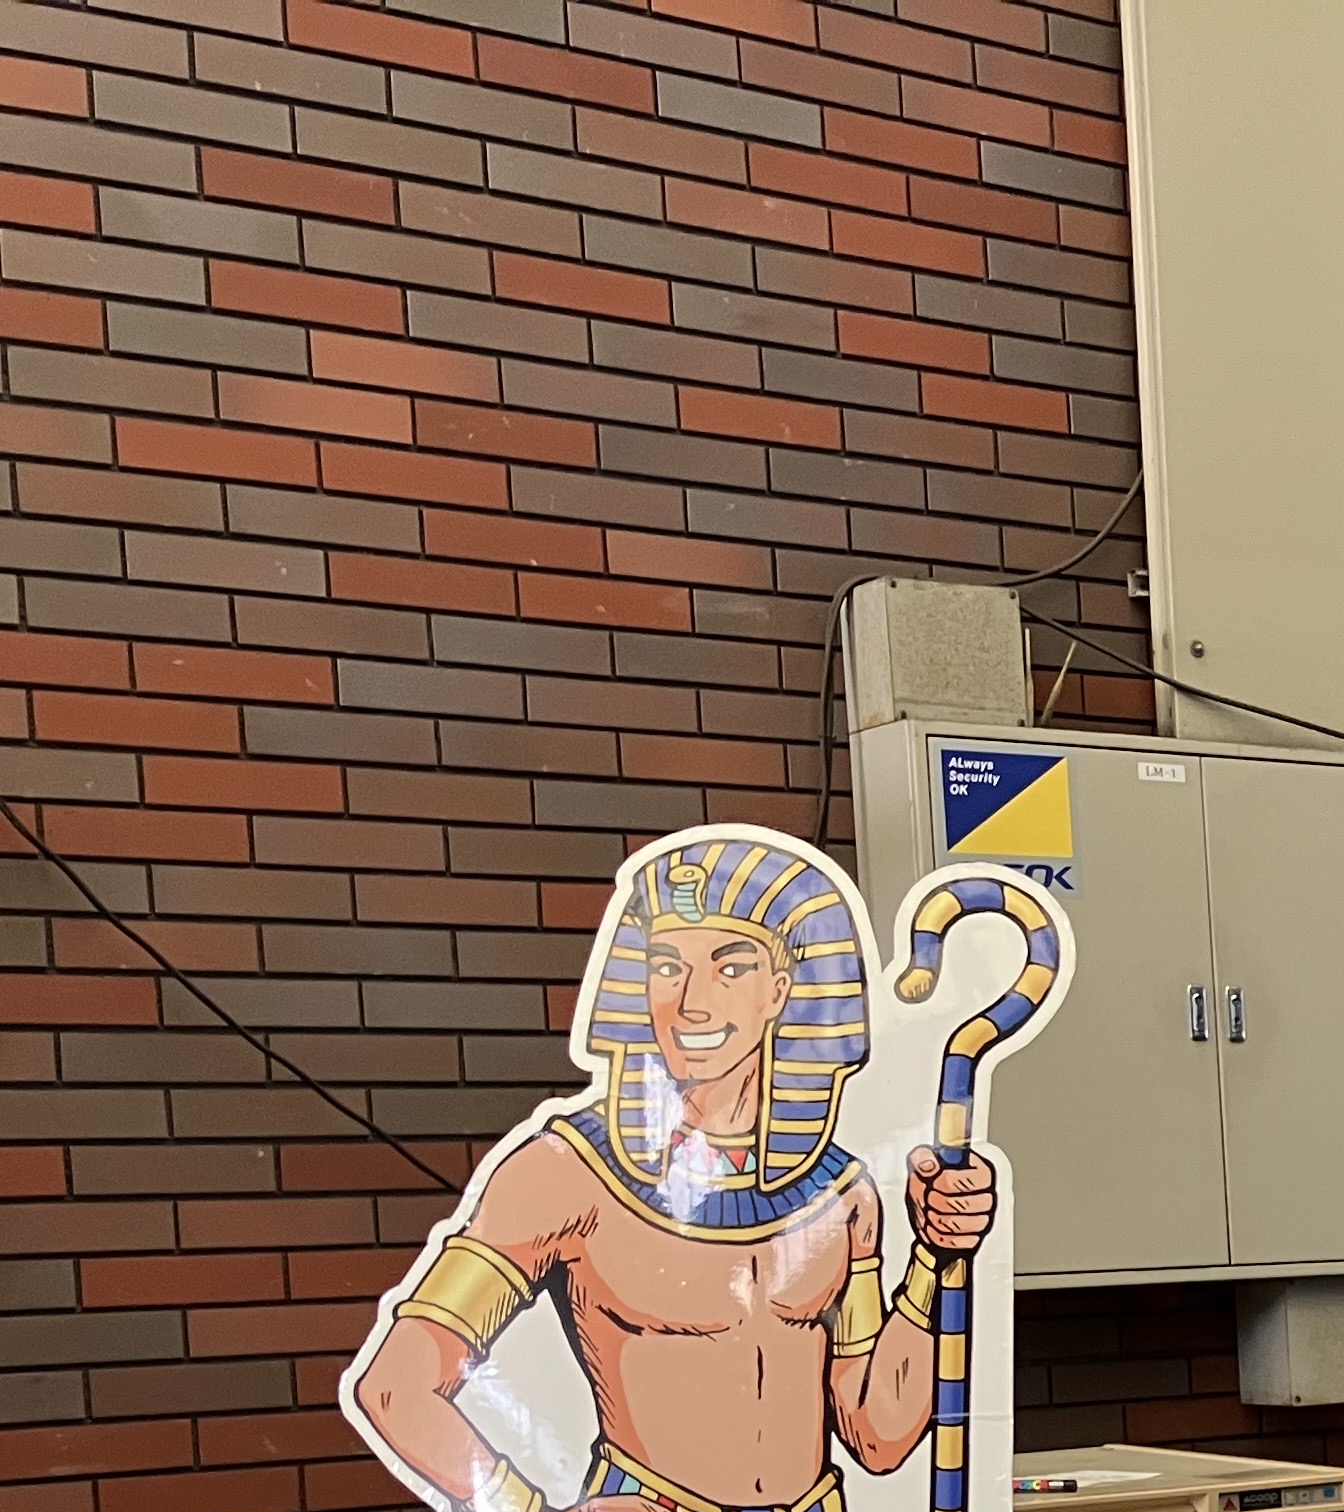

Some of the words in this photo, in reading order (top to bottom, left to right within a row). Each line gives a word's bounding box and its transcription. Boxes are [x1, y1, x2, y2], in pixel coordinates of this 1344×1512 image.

[949, 770, 1000, 786] Security
[1145, 765, 1177, 779] LM-1
[950, 784, 968, 795] OK
